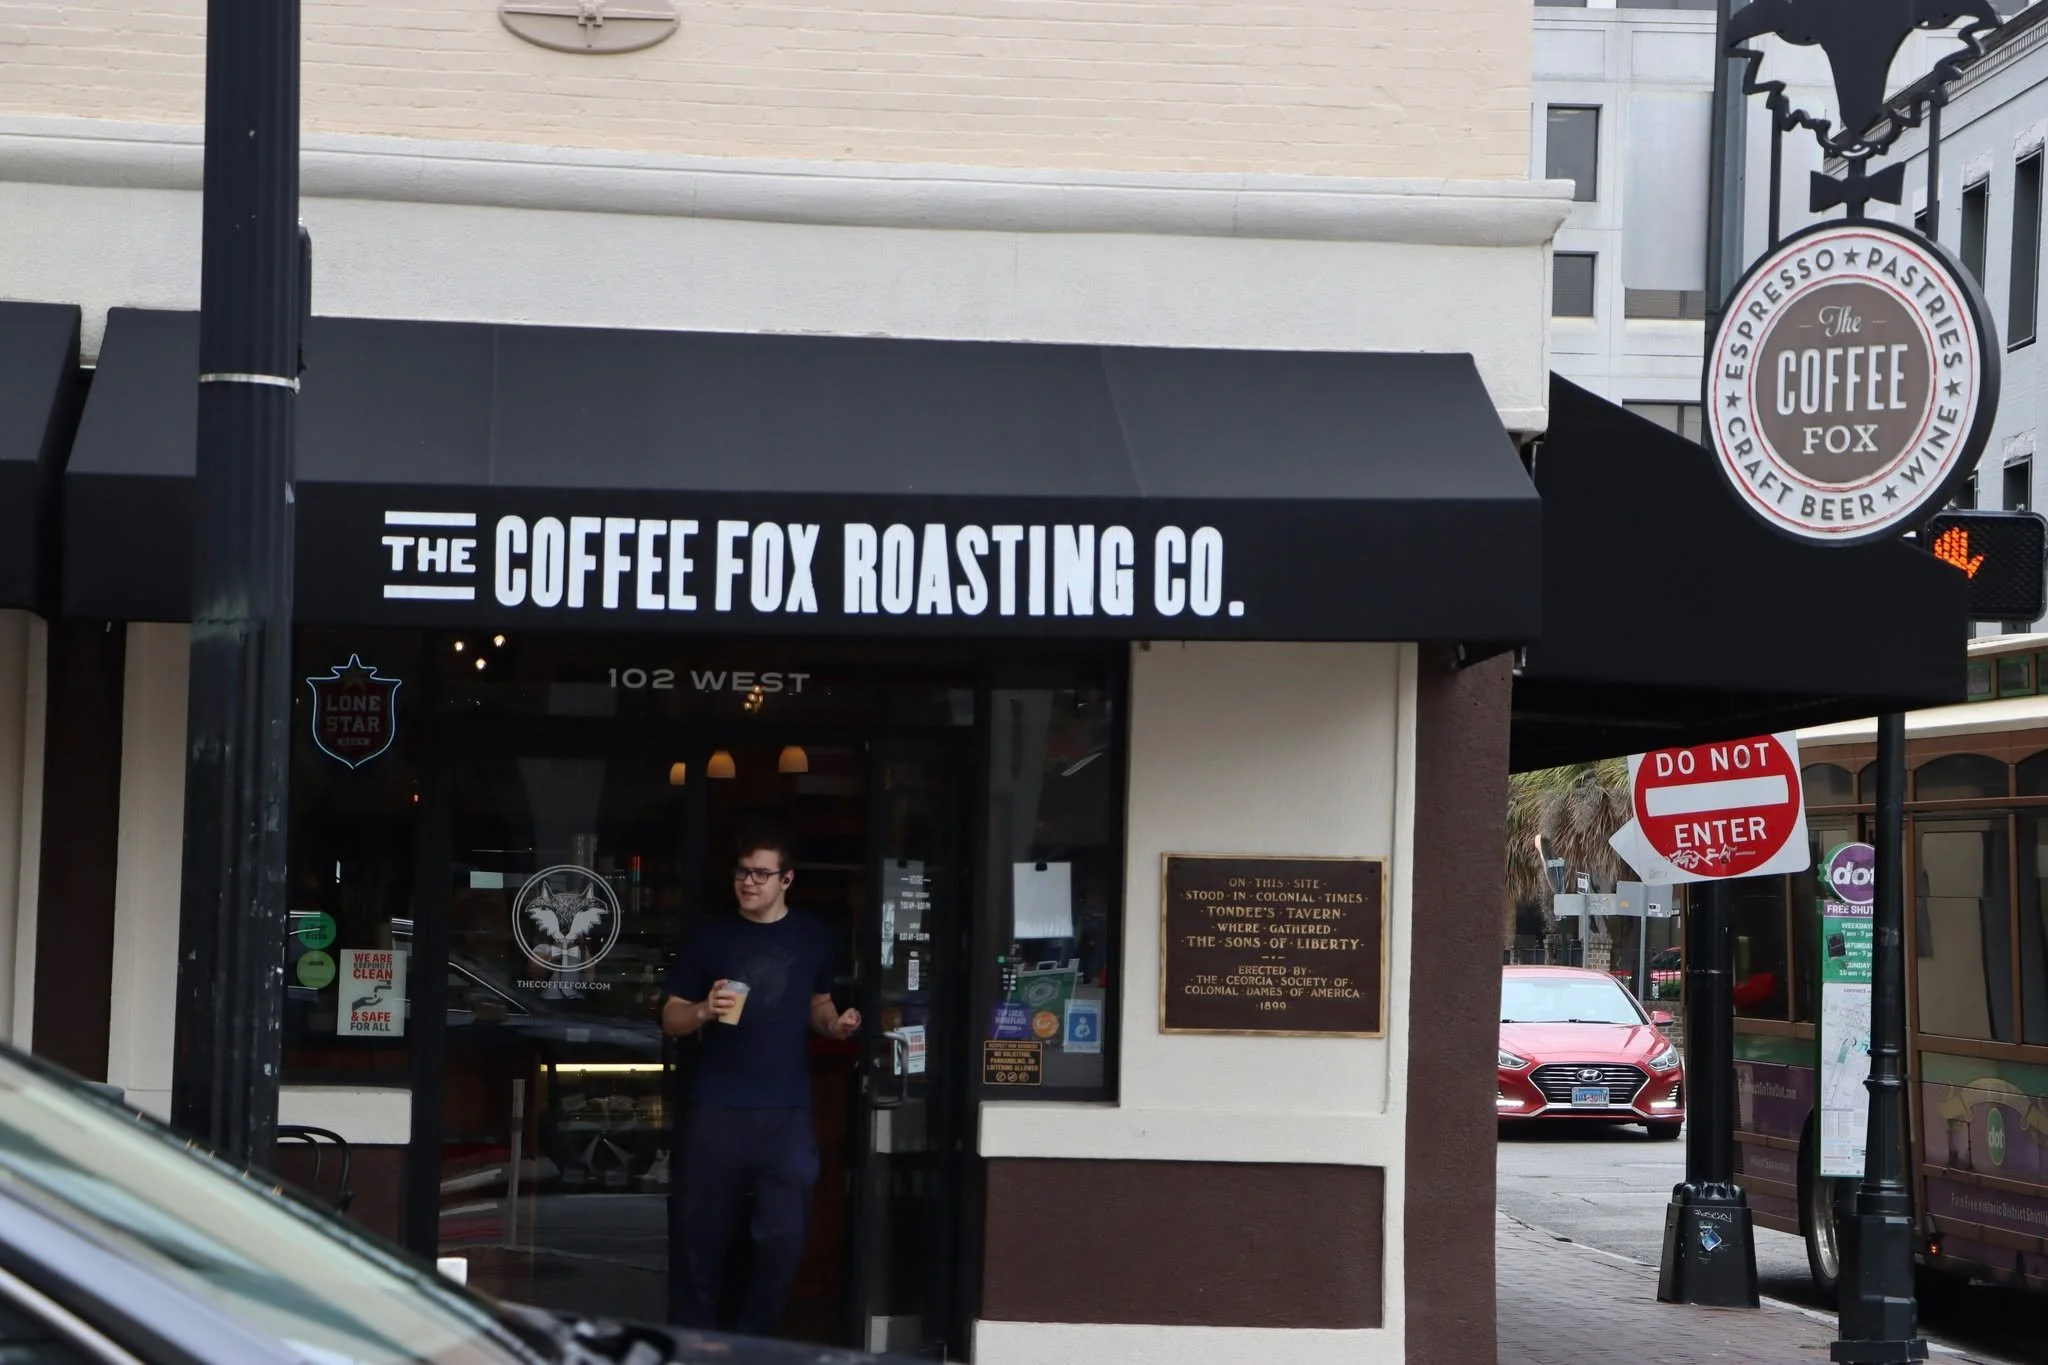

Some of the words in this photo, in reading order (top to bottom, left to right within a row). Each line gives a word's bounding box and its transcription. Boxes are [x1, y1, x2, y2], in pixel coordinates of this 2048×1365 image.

[1726, 249, 1834, 380] ESPRESSO
[1866, 247, 1963, 369] PASTRIES
[1818, 305, 1863, 337] The
[1776, 344, 1908, 415] COFFEE
[1802, 424, 1879, 455] FOX
[1900, 405, 1958, 485] WINE
[1728, 416, 1793, 504] CRAFT
[1800, 493, 1877, 520] BEER
[381, 535, 477, 574] THE
[494, 515, 699, 610] COFFEE
[714, 520, 820, 613] FOX
[843, 523, 1134, 616] ROASTING
[1154, 525, 1245, 616] CO.
[608, 668, 675, 689] 102
[690, 670, 810, 693] WEST
[326, 695, 381, 712] LONE
[326, 715, 381, 732] STAR
[1655, 750, 1695, 777] DO
[1710, 742, 1769, 771] NOT
[1674, 816, 1767, 848] ENTER
[1229, 878, 1245, 887] ON
[1255, 878, 1283, 888] THIS
[1293, 879, 1319, 889] SITE
[1186, 891, 1224, 900] STOOD
[1233, 891, 1246, 900] IN
[1256, 892, 1315, 902] COLONIAL
[1324, 893, 1362, 903] TIMES
[1207, 906, 1275, 918] TONDEE'S
[1286, 907, 1341, 919] TAVERN
[1827, 904, 1849, 914] FREE
[1217, 923, 1260, 933] WHERE
[1269, 924, 1331, 934] GATHERED
[1187, 936, 1216, 947] THE
[1224, 936, 1260, 948] SONS
[1269, 937, 1288, 949] OF
[1297, 938, 1360, 950] LIBERTY
[354, 953, 370, 962] WE
[372, 953, 392, 963] ARE
[353, 969, 392, 979] CLEAN
[1238, 965, 1286, 975] ERECTED
[1293, 966, 1308, 976] BY
[516, 980, 610, 990] THECOFFEEFOX.COM
[1196, 975, 1217, 984] THE
[1281, 976, 1327, 987] SOCIETY
[1334, 978, 1349, 987] OF
[1185, 985, 1239, 996] COLONIAL
[1246, 986, 1283, 997] DAMES
[1290, 987, 1304, 997] OF
[1310, 988, 1360, 998] AMERICA
[1260, 1001, 1287, 1010] 1899
[351, 1012, 359, 1022] &
[361, 1012, 391, 1022] SAFE
[350, 1022, 370, 1031] FOR
[372, 1022, 390, 1031] ALL
[1989, 1126, 2003, 1149] dot
